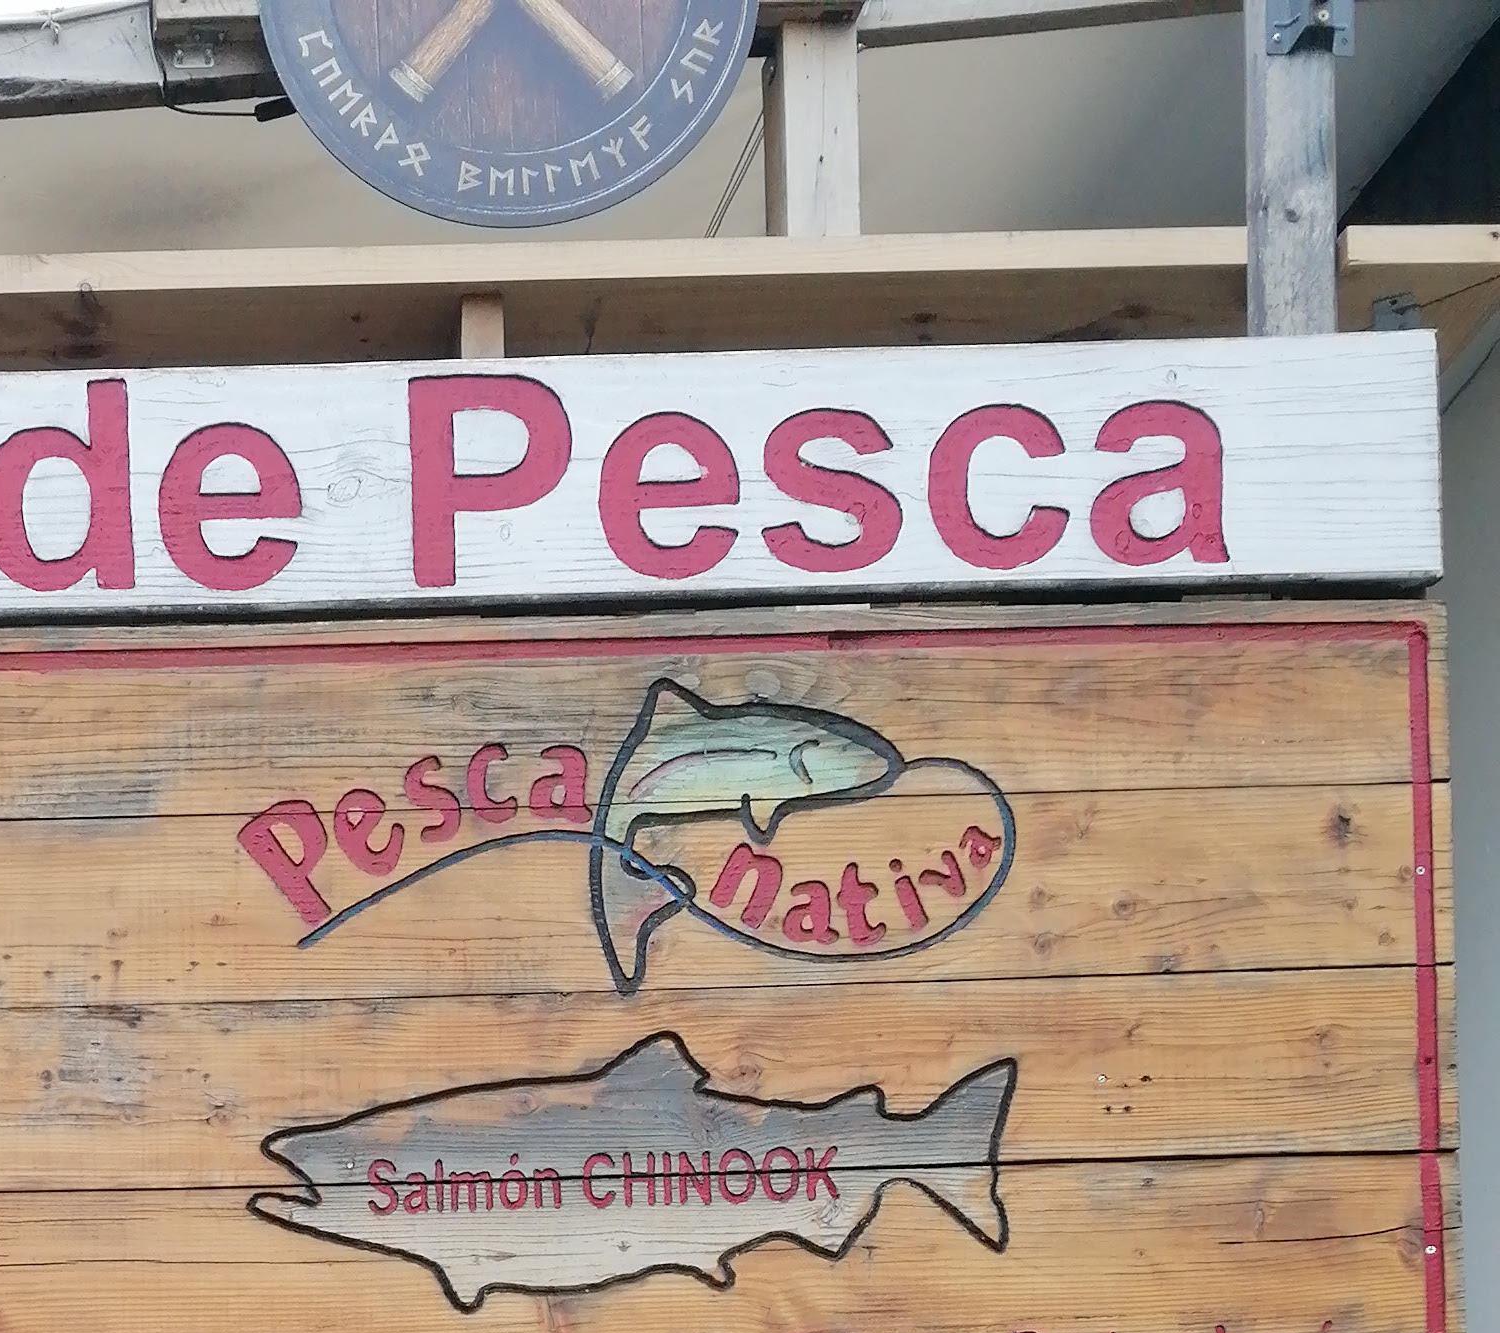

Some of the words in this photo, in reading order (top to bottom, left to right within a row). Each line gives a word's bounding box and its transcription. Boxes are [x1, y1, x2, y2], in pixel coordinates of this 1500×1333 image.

[406, 373, 1231, 588] Pesca
[237, 742, 593, 928] Pesca
[366, 1152, 563, 1217] Salmón
[581, 1145, 840, 1210] CHINOOK
